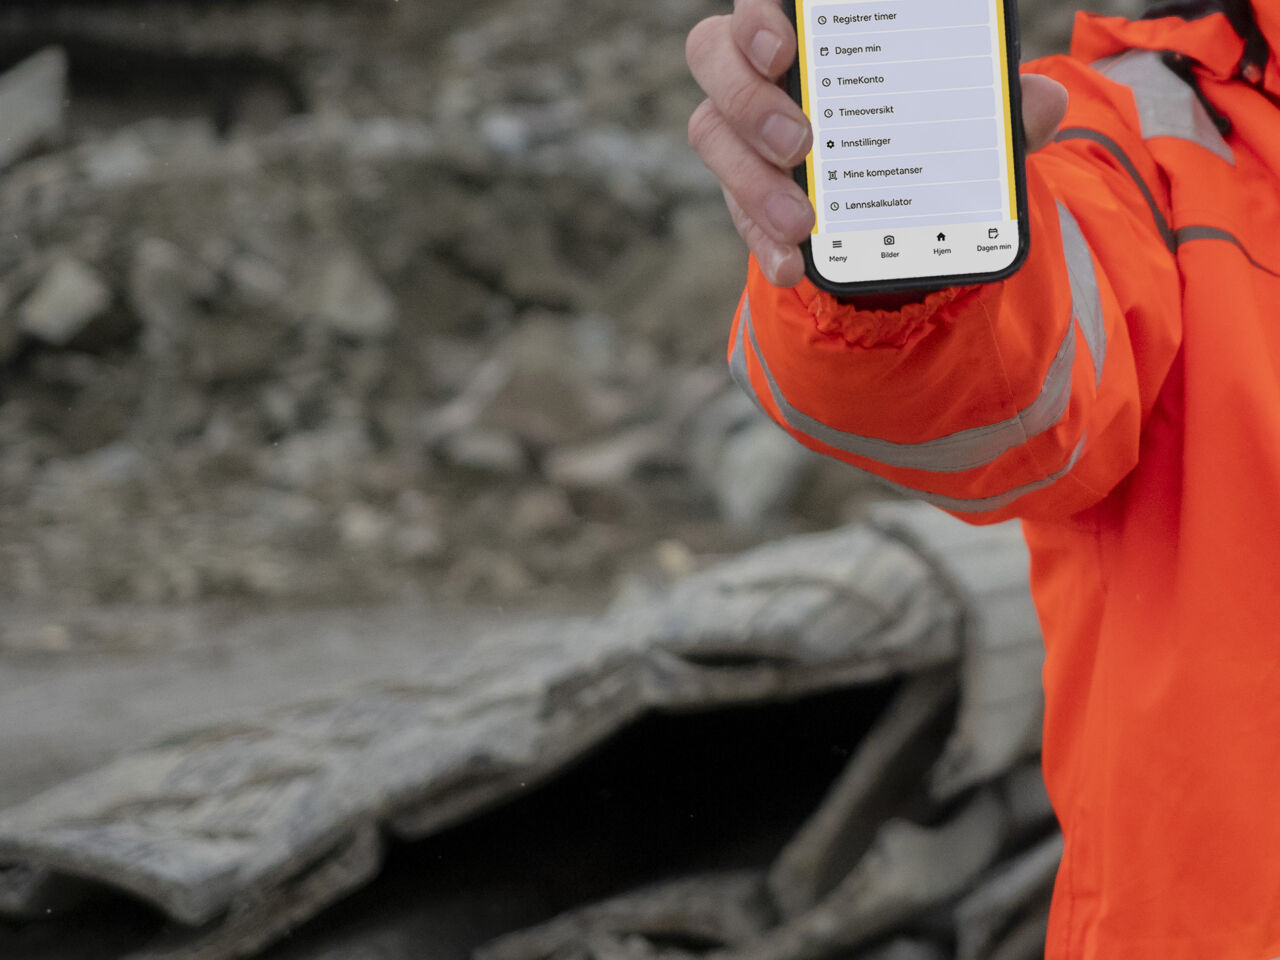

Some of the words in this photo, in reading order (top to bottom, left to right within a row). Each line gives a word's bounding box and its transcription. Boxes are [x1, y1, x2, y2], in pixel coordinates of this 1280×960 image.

[833, 14, 872, 24] Registrer
[874, 12, 897, 21] timer
[835, 46, 863, 55] Dagen
[865, 44, 882, 52] min
[837, 76, 885, 86] TimeKonto
[839, 106, 894, 117] Timeoversikt
[841, 138, 891, 148] Innstillinger
[843, 170, 865, 179] Mine
[866, 167, 923, 178] kompetanser
[845, 199, 912, 210] Lønnskalkulator
[933, 247, 952, 256] Hjem
[976, 245, 998, 253] Dagen
[999, 242, 1012, 251] min
[829, 255, 847, 264] Meny
[881, 251, 899, 259] Bilder
